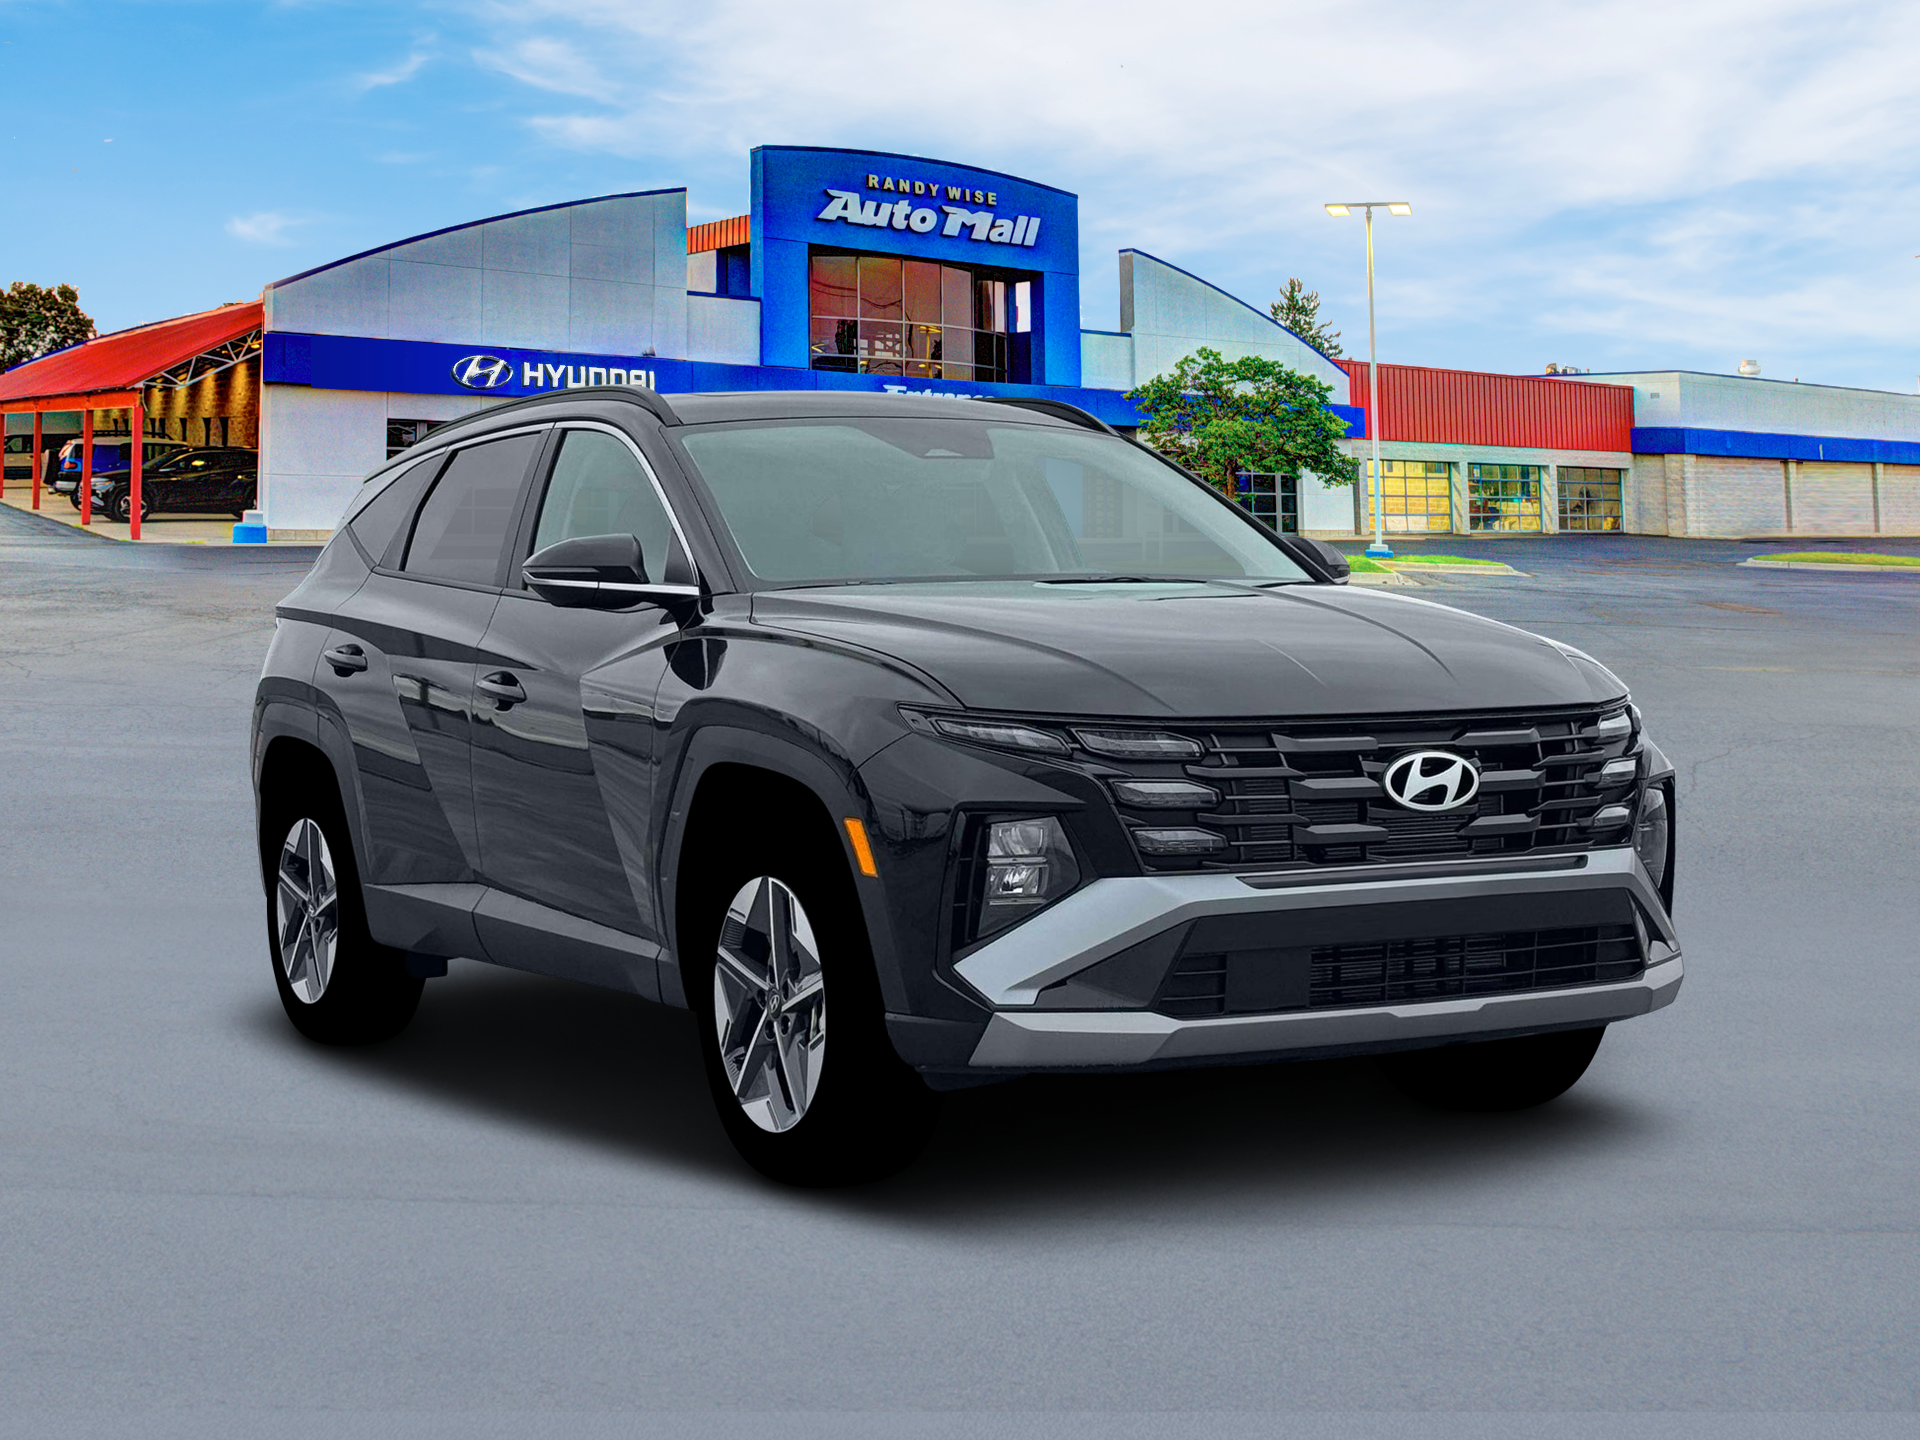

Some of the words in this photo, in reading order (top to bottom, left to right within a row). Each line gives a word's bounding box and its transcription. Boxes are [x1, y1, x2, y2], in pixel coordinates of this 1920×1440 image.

[866, 173, 940, 197] RANDY
[944, 185, 998, 206] WISE
[817, 187, 937, 234] Auto
[940, 204, 1042, 247] Mall
[521, 360, 656, 391] HYUNDAI
